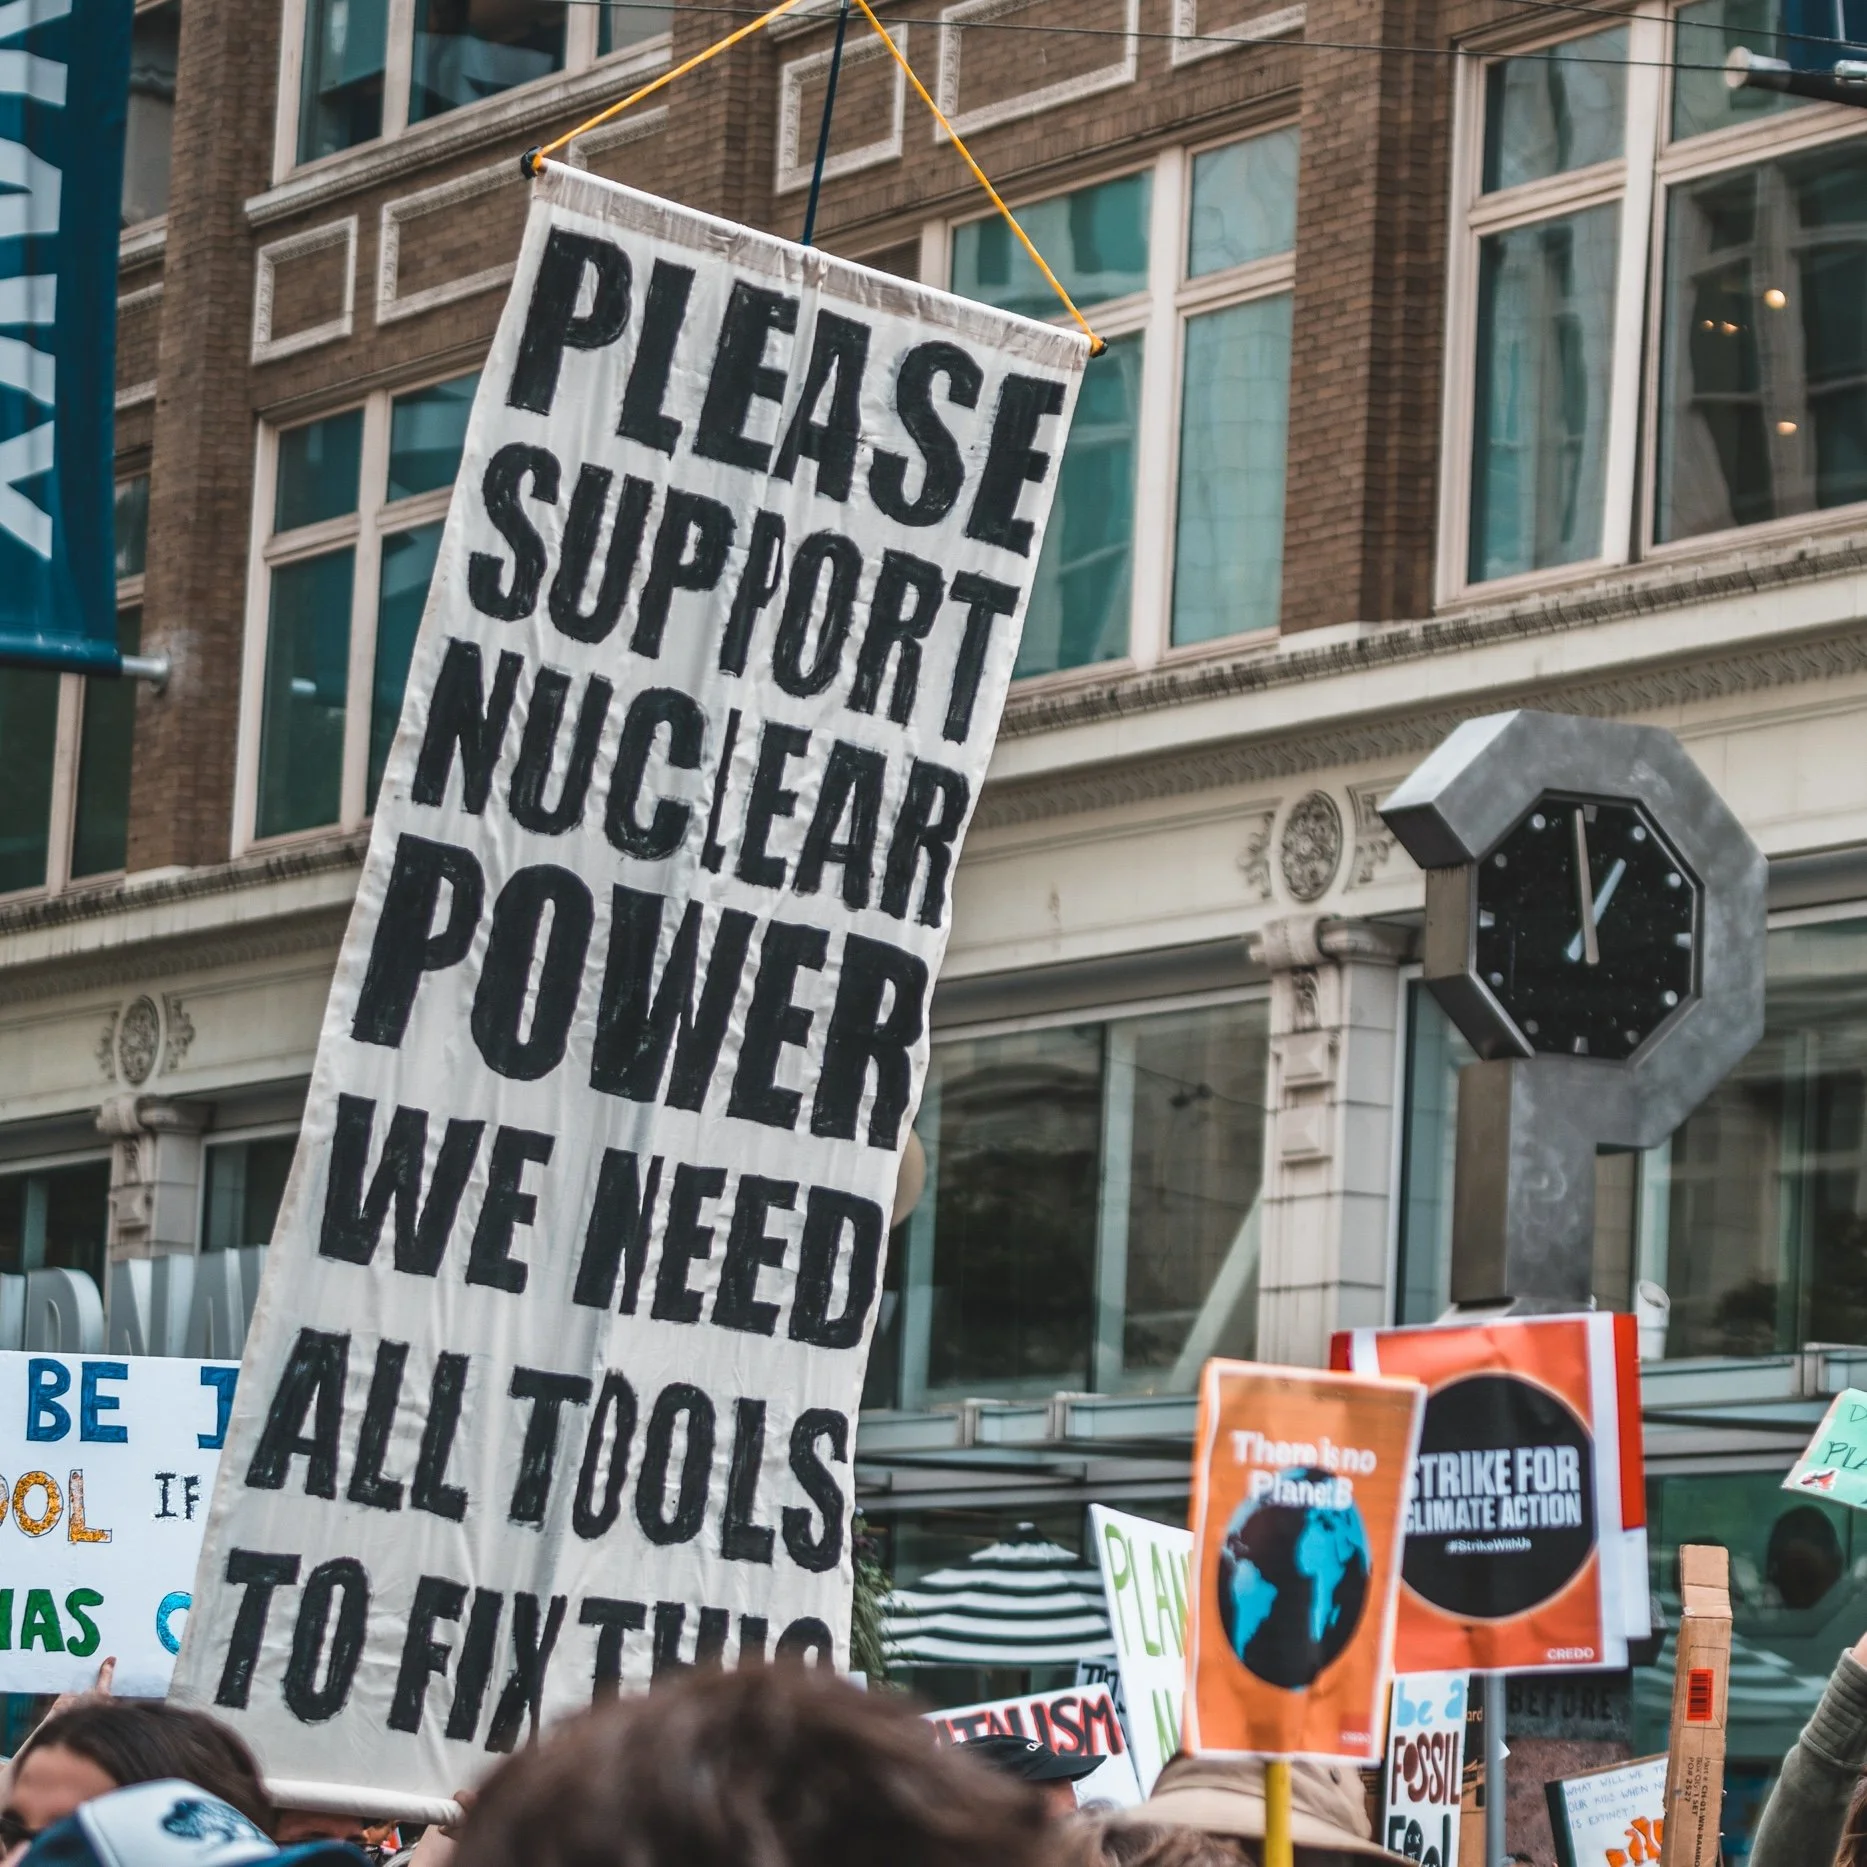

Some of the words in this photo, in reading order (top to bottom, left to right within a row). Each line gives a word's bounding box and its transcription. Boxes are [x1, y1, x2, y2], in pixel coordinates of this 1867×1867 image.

[507, 224, 1066, 558] PLEASE
[469, 442, 1020, 746] SUPPORT
[412, 636, 971, 928] NUCLEAR
[350, 832, 929, 1151] POWER
[319, 1092, 556, 1294] WE
[573, 1146, 884, 1349] NEED
[27, 1358, 129, 1444] BE
[245, 1326, 468, 1522] ALL
[508, 1365, 848, 1574] TOOLS
[1318, 1436, 1341, 1471] is
[1342, 1449, 1378, 1475] no
[1514, 1444, 1580, 1495] FOR
[0, 1468, 112, 1543] OL
[154, 1472, 200, 1520] IF
[1334, 1475, 1354, 1510] B
[1500, 1493, 1582, 1530] ACTION
[1445, 1535, 1532, 1555] #StrikeWithUs
[213, 1546, 371, 1723] TO
[387, 1574, 567, 1753] FIX
[1547, 1646, 1594, 1661] CREDO
[1396, 1678, 1433, 1727] be
[1444, 1678, 1465, 1719] a
[1391, 1731, 1460, 1806] FOSSIL
[1565, 1782, 1593, 1797] WHAT
[1600, 1775, 1626, 1788] WILL
[1630, 1769, 1643, 1780] WE
[1685, 1779, 1693, 1803] 2527
[1568, 1800, 1588, 1814] OUR
[1620, 1785, 1649, 1798] WHEN
[1570, 1820, 1583, 1830] IS
